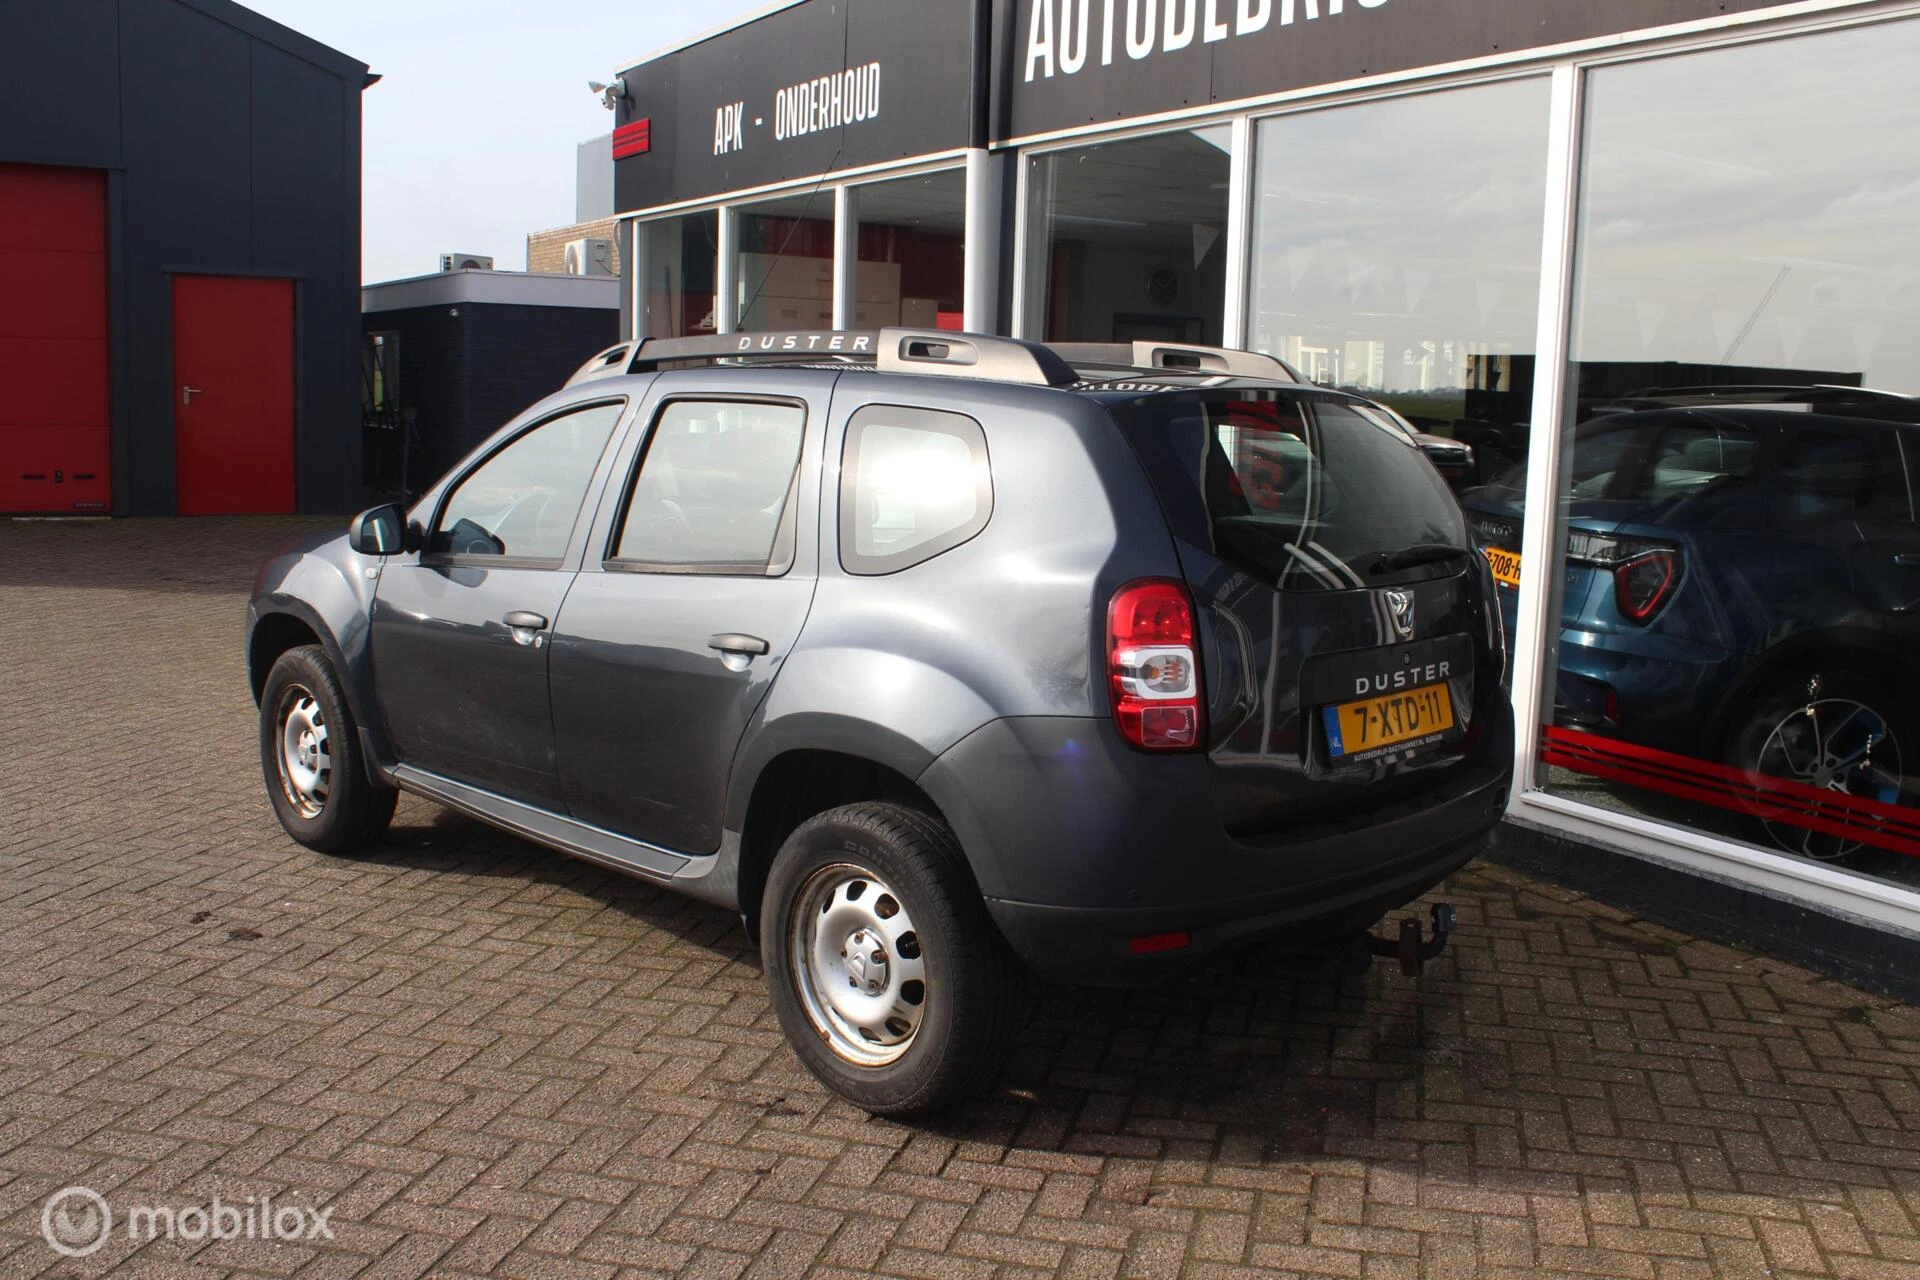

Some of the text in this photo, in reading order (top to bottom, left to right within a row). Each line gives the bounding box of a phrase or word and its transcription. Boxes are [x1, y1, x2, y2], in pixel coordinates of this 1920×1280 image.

[714, 101, 744, 155] APK
[775, 61, 881, 141] ONDERHOUD
[738, 335, 870, 350] DUSTER
[1355, 661, 1450, 694] DUSTER
[1354, 690, 1443, 744] 7-XTD-11
